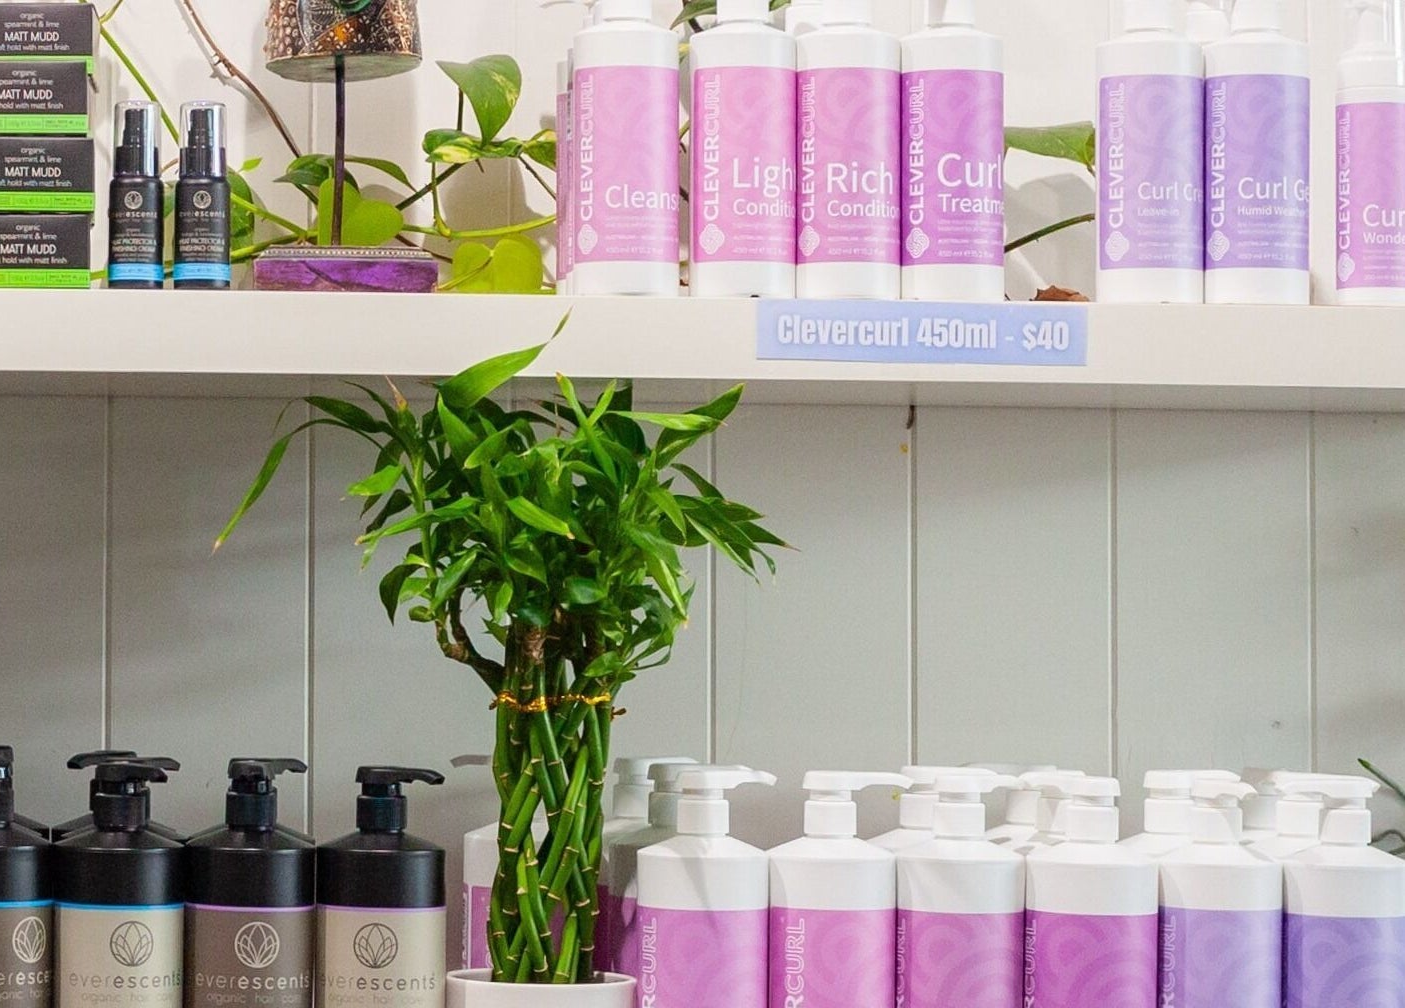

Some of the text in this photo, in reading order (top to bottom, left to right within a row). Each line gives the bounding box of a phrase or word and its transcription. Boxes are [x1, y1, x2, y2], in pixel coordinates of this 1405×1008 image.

[4, 31, 60, 42] MATT MUDD
[23, 89, 53, 100] MUDD
[580, 74, 597, 222] CLEVERCURL
[703, 73, 722, 222] CLEVERCURL
[802, 76, 816, 222] CLEVERCURL
[908, 78, 925, 226] CLEVERCURL
[1108, 82, 1125, 229] CLEVERCURL
[1211, 82, 1227, 229] CLEVERCURL
[5, 166, 62, 178] MATT MUDD
[734, 157, 795, 198] Ligh
[826, 161, 893, 195] Rich
[937, 153, 1003, 189] Curl
[1339, 111, 1352, 251] CLEVERCURL
[605, 184, 678, 212] Cleans
[1138, 181, 1178, 202] Curl
[1238, 176, 1289, 202] Curl
[0, 243, 57, 255] MATT MUDD
[777, 314, 909, 350] Clevercurl
[917, 318, 997, 351] 450ml
[1021, 321, 1070, 354] $40
[196, 971, 310, 990] everescents
[320, 973, 436, 992] everescents
